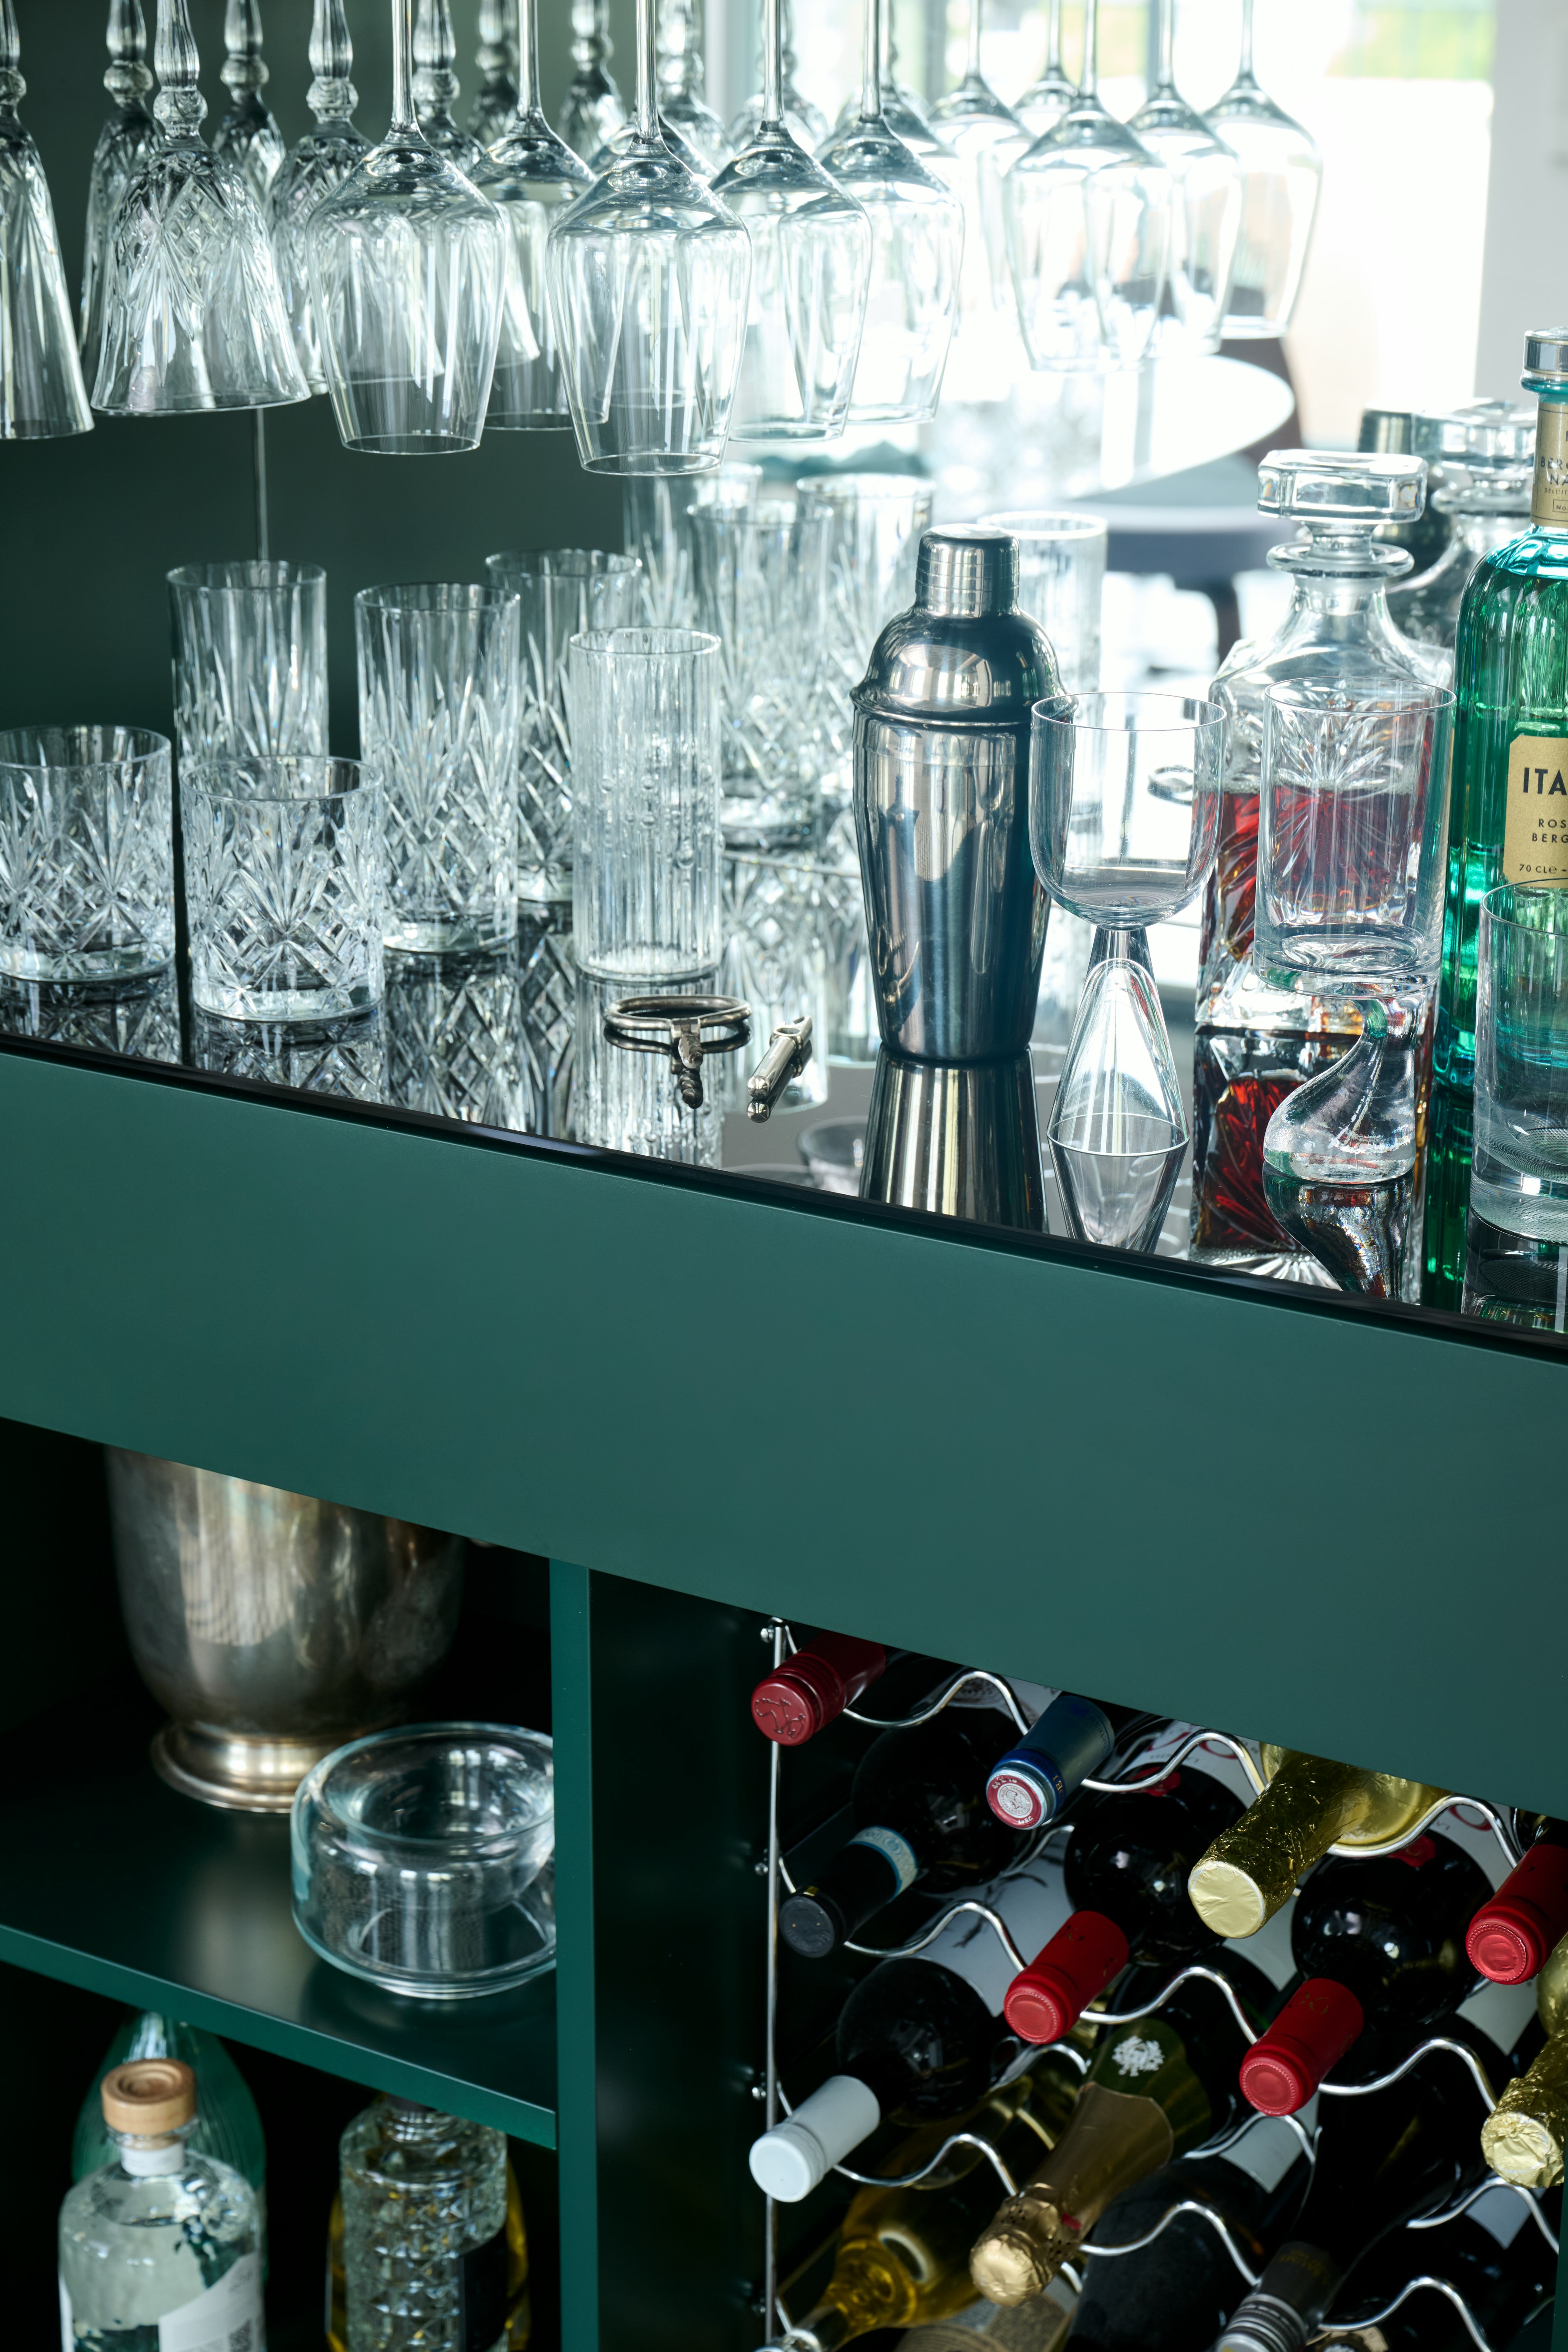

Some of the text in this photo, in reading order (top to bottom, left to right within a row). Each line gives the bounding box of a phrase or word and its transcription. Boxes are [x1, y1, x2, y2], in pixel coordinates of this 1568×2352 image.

[1541, 456, 1568, 470] BER
[1523, 767, 1567, 796] ITA
[1538, 818, 1567, 828] ROS
[1532, 832, 1568, 843] BERG
[1519, 864, 1531, 872] 70
